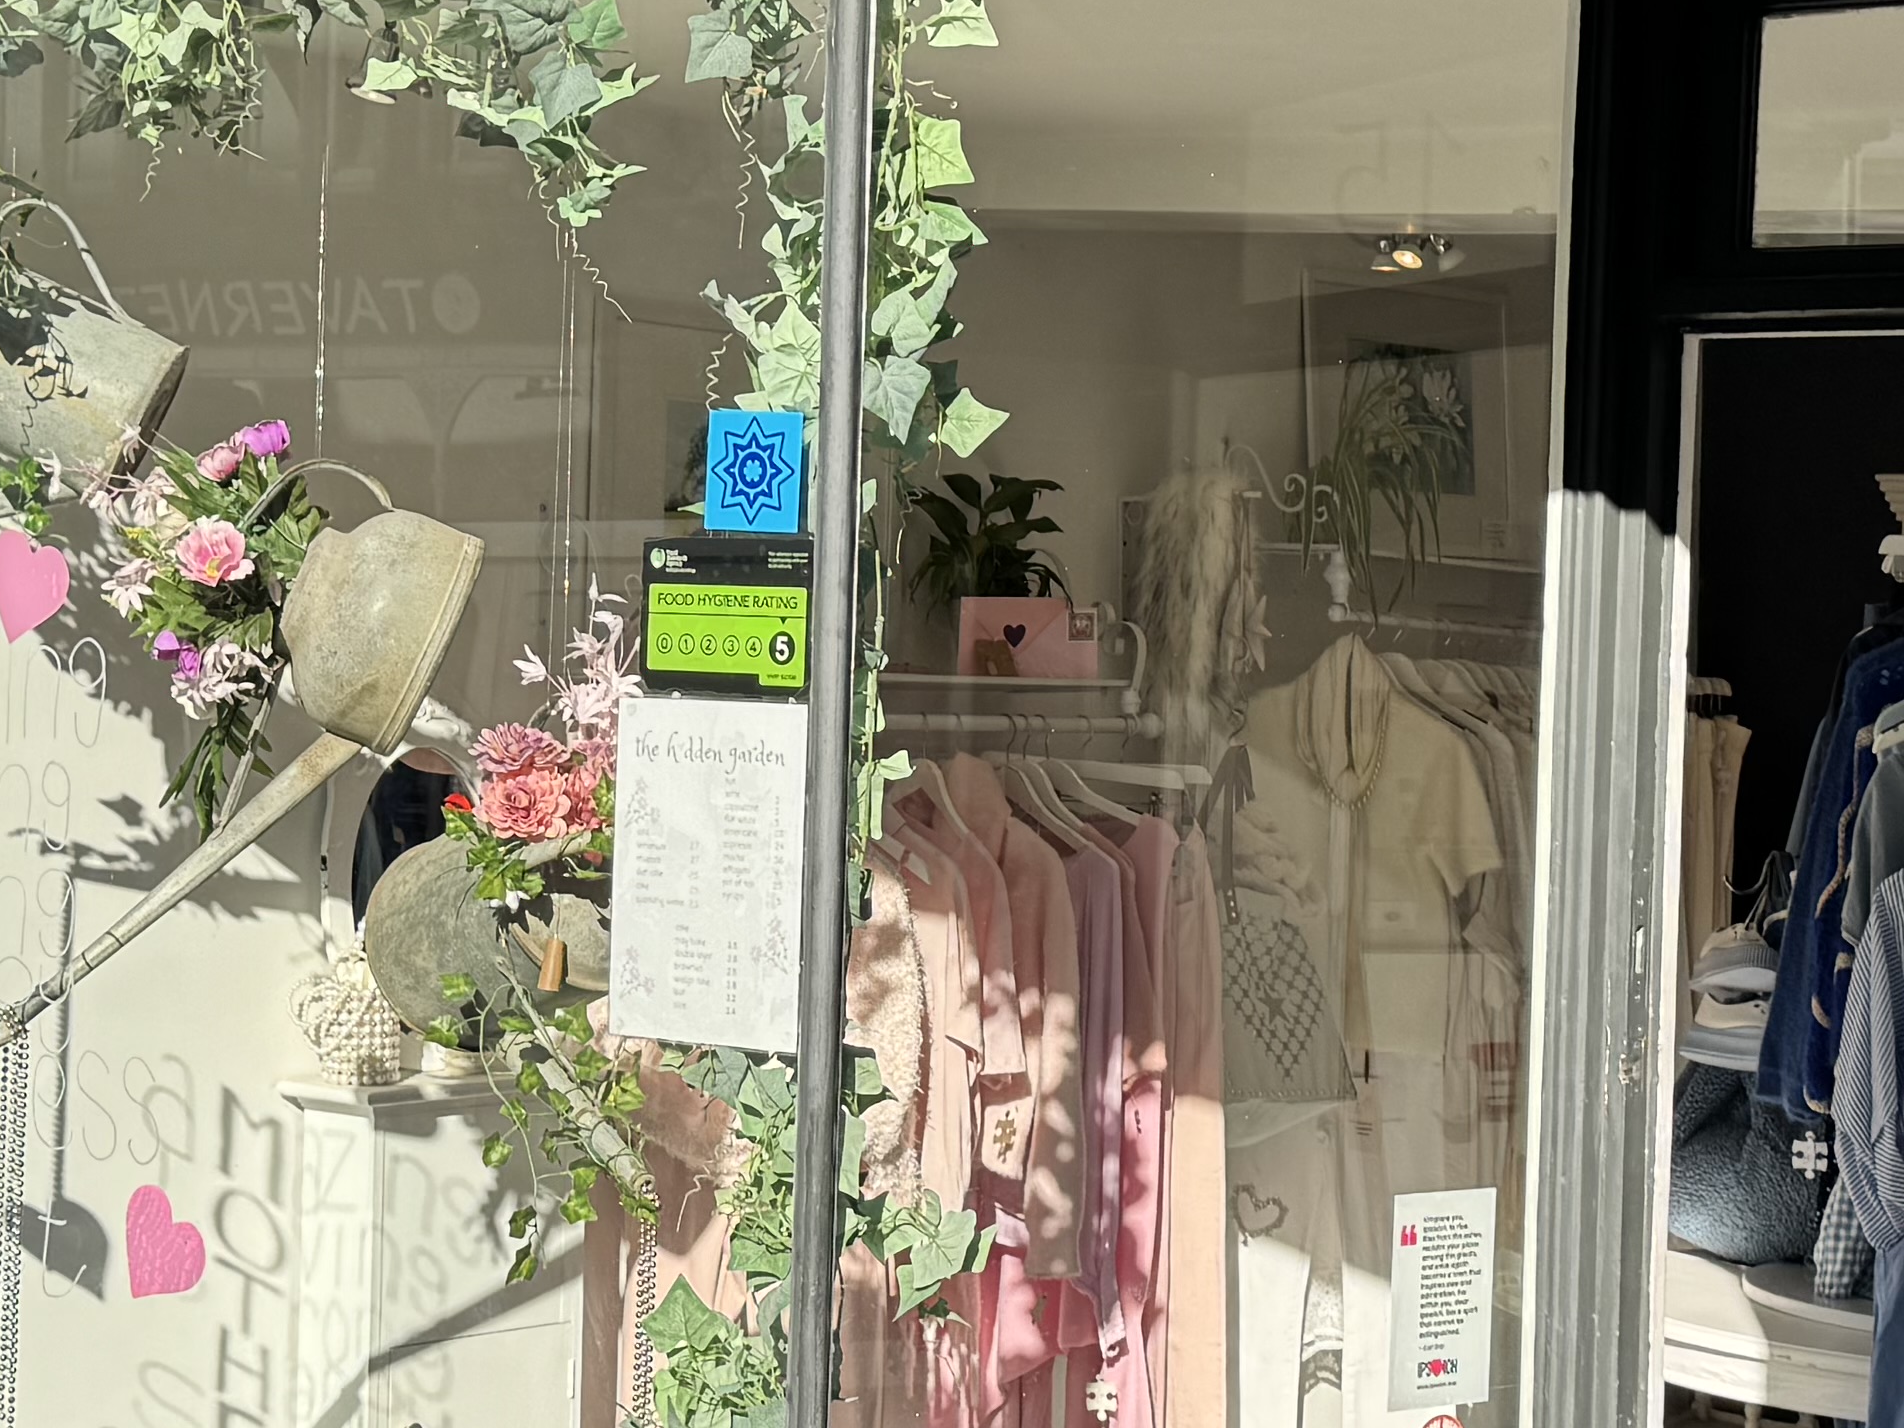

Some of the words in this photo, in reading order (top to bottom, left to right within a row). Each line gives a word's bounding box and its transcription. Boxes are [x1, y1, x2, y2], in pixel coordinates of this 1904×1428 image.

[657, 593, 695, 606] FOOD
[698, 594, 750, 608] HYGIENE
[753, 596, 798, 609] RATING
[774, 635, 790, 661] 5
[636, 730, 659, 762] the
[725, 740, 785, 774] garden
